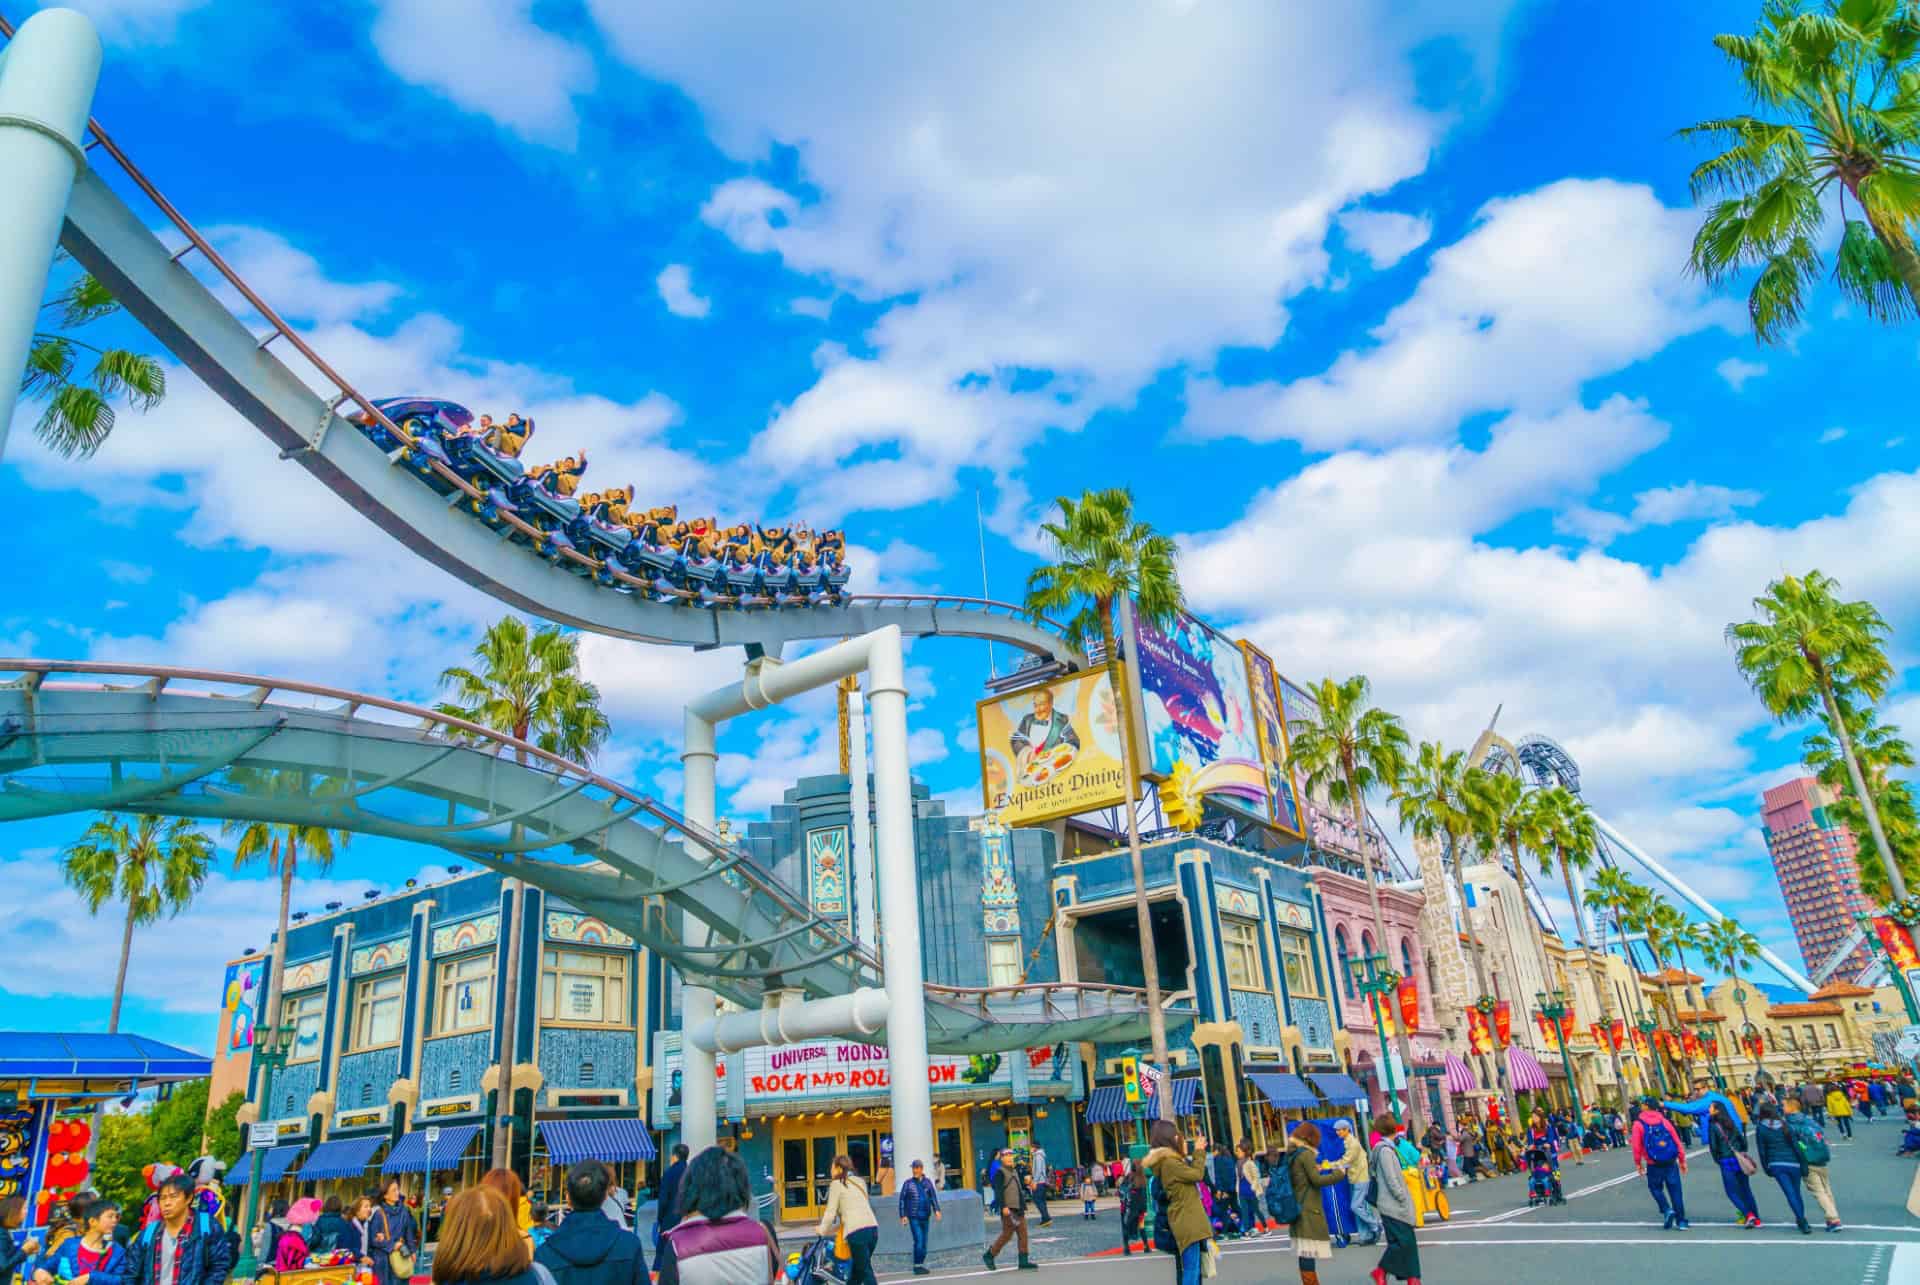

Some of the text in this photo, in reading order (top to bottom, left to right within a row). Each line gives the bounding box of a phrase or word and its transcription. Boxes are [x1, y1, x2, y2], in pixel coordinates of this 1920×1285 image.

[993, 767, 1126, 811] Exquisite Dining
[770, 1046, 828, 1070] UNIVERSAL
[751, 1071, 808, 1094] ROCK
[811, 1070, 846, 1088] AND
